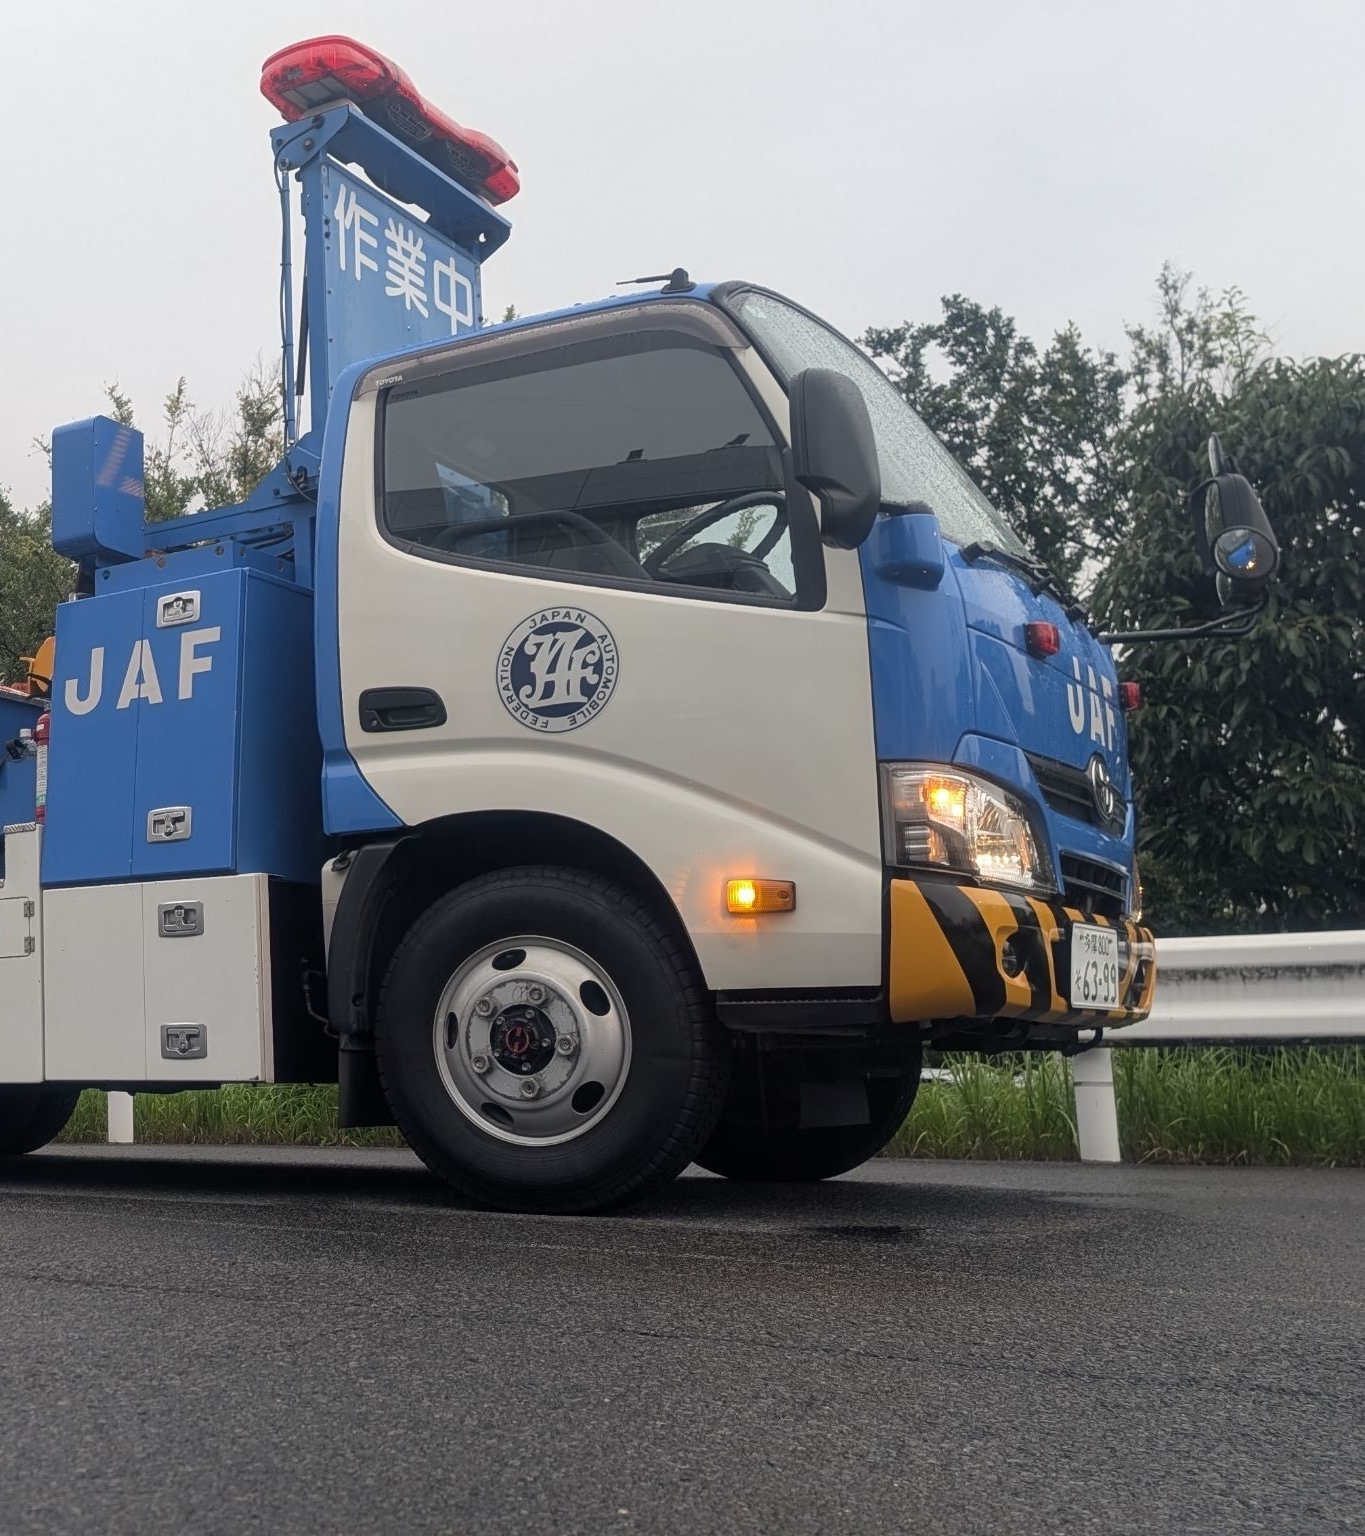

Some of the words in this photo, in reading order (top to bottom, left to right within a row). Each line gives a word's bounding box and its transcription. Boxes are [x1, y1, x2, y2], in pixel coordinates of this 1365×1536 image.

[333, 183, 474, 336] 作業中
[375, 375, 404, 387] TOYOTA
[528, 610, 587, 630] JAPAN
[64, 625, 222, 716] JAF
[499, 645, 550, 729] FEDERATION
[567, 633, 615, 727] AUTOMOBILE
[1066, 655, 1115, 752] JAF
